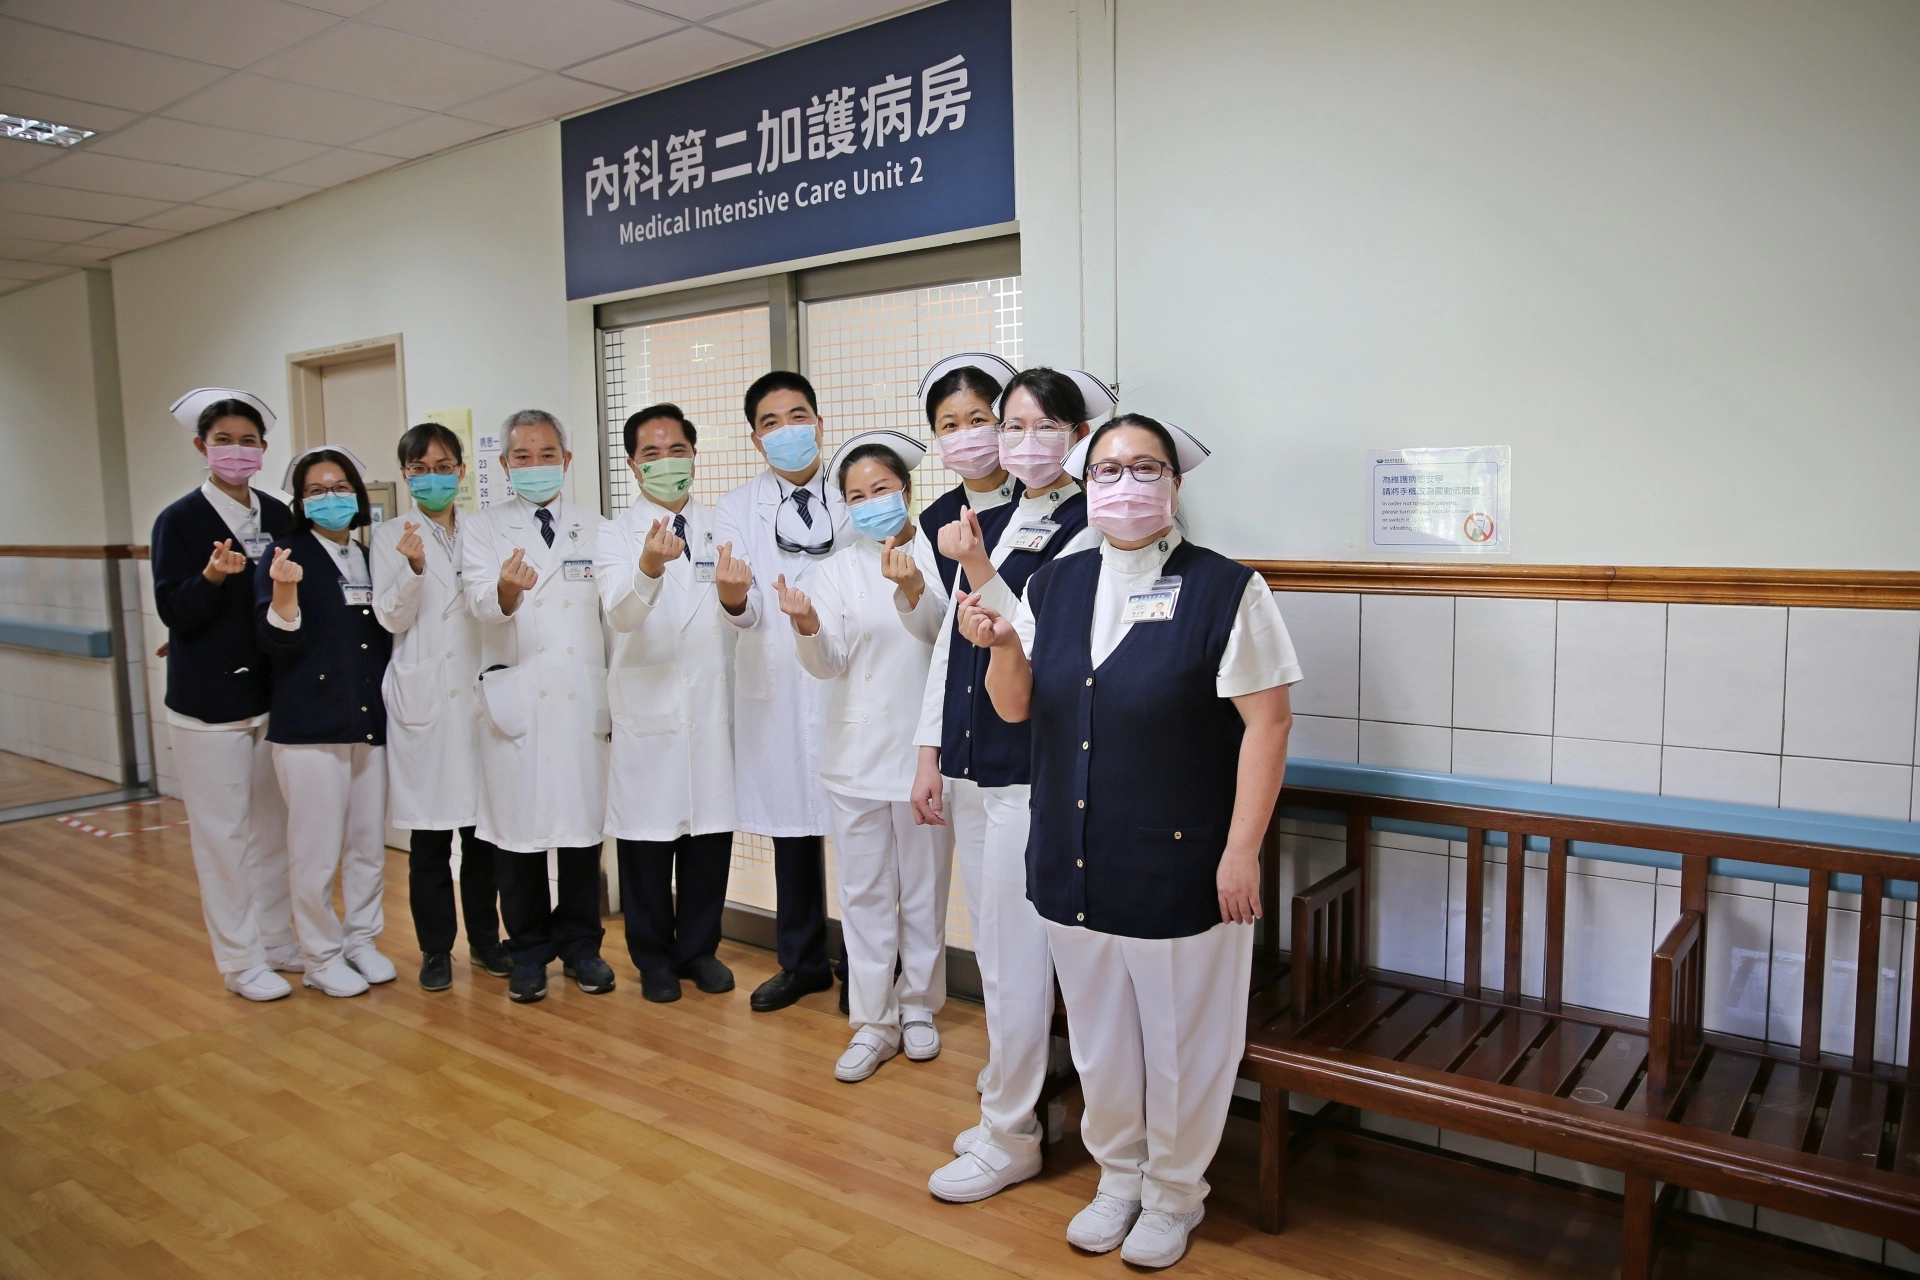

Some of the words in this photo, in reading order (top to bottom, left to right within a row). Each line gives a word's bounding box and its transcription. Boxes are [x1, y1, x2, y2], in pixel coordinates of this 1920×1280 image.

[586, 54, 971, 216] 內科第二加護病房
[619, 207, 690, 245] Medical
[695, 190, 789, 229] Intensive
[795, 179, 847, 207] Care
[853, 161, 903, 195] Unit
[909, 156, 924, 184] 2
[478, 459, 488, 470] 23
[480, 474, 488, 484] 25
[480, 488, 489, 498] 26
